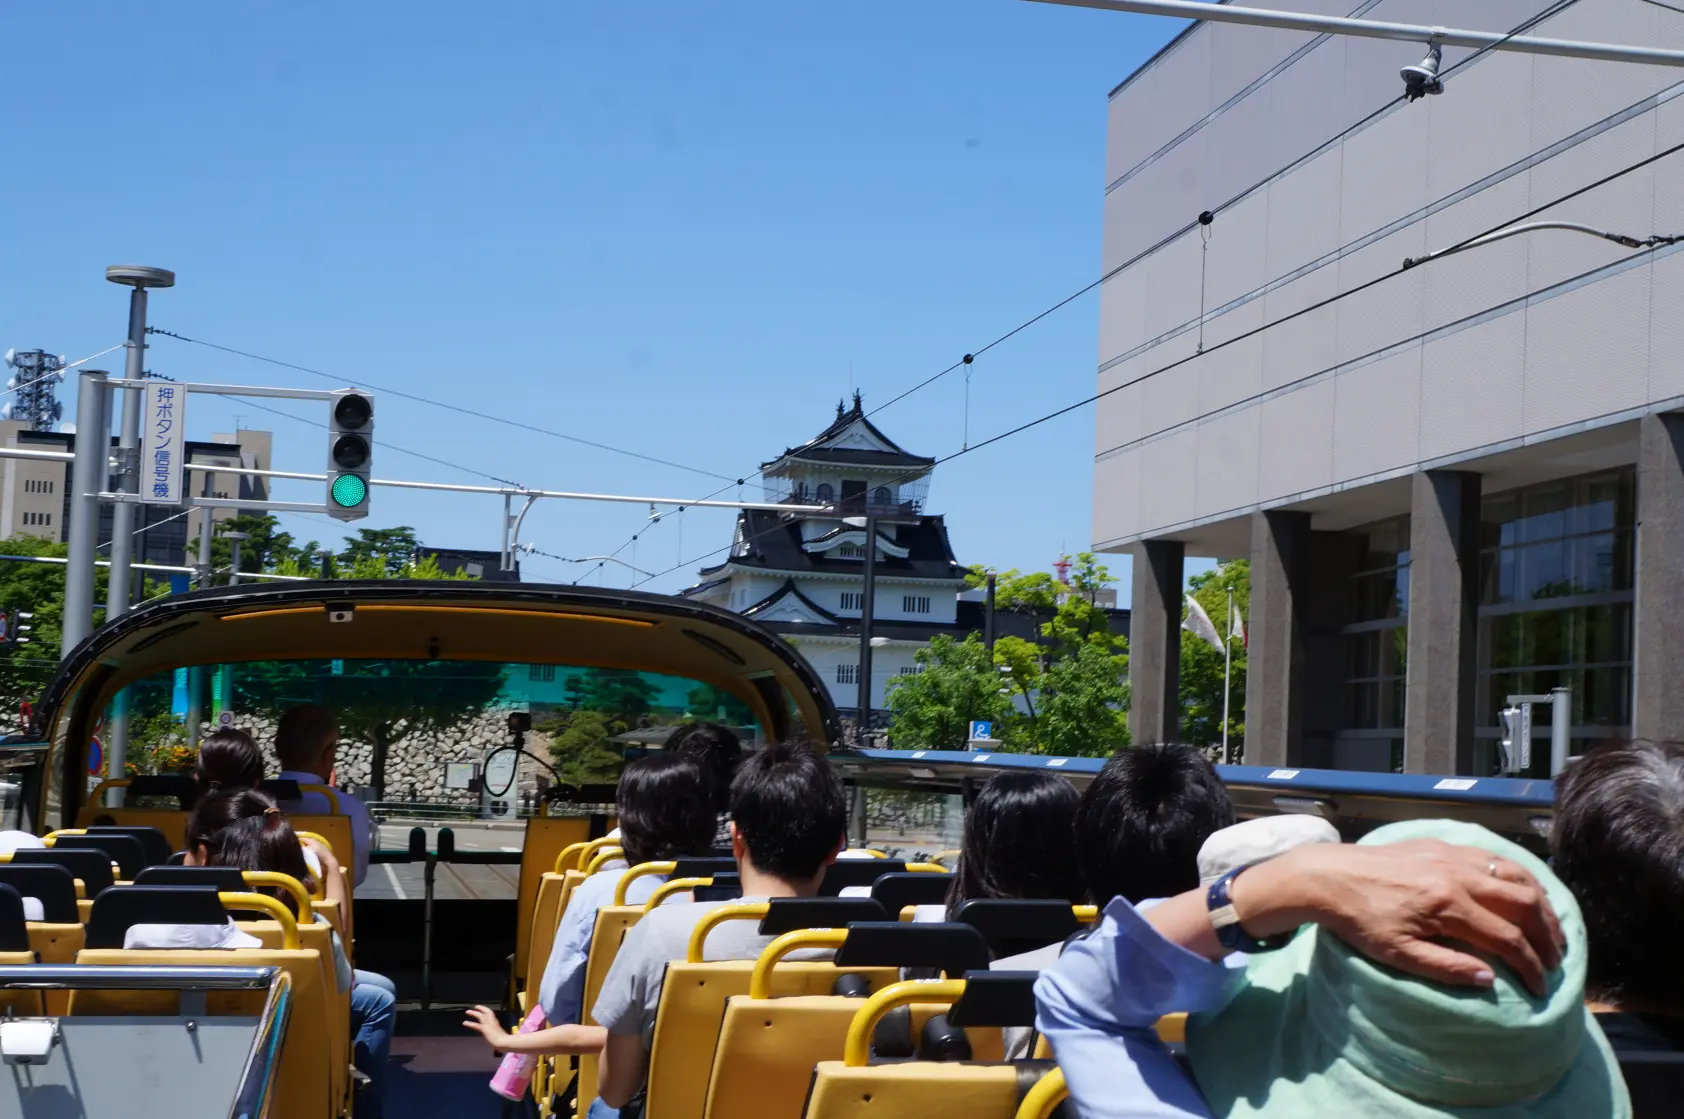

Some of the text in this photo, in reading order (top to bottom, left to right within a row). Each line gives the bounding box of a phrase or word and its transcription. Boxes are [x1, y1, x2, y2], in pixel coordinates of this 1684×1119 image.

[153, 387, 174, 498] 押ボタン信号機
